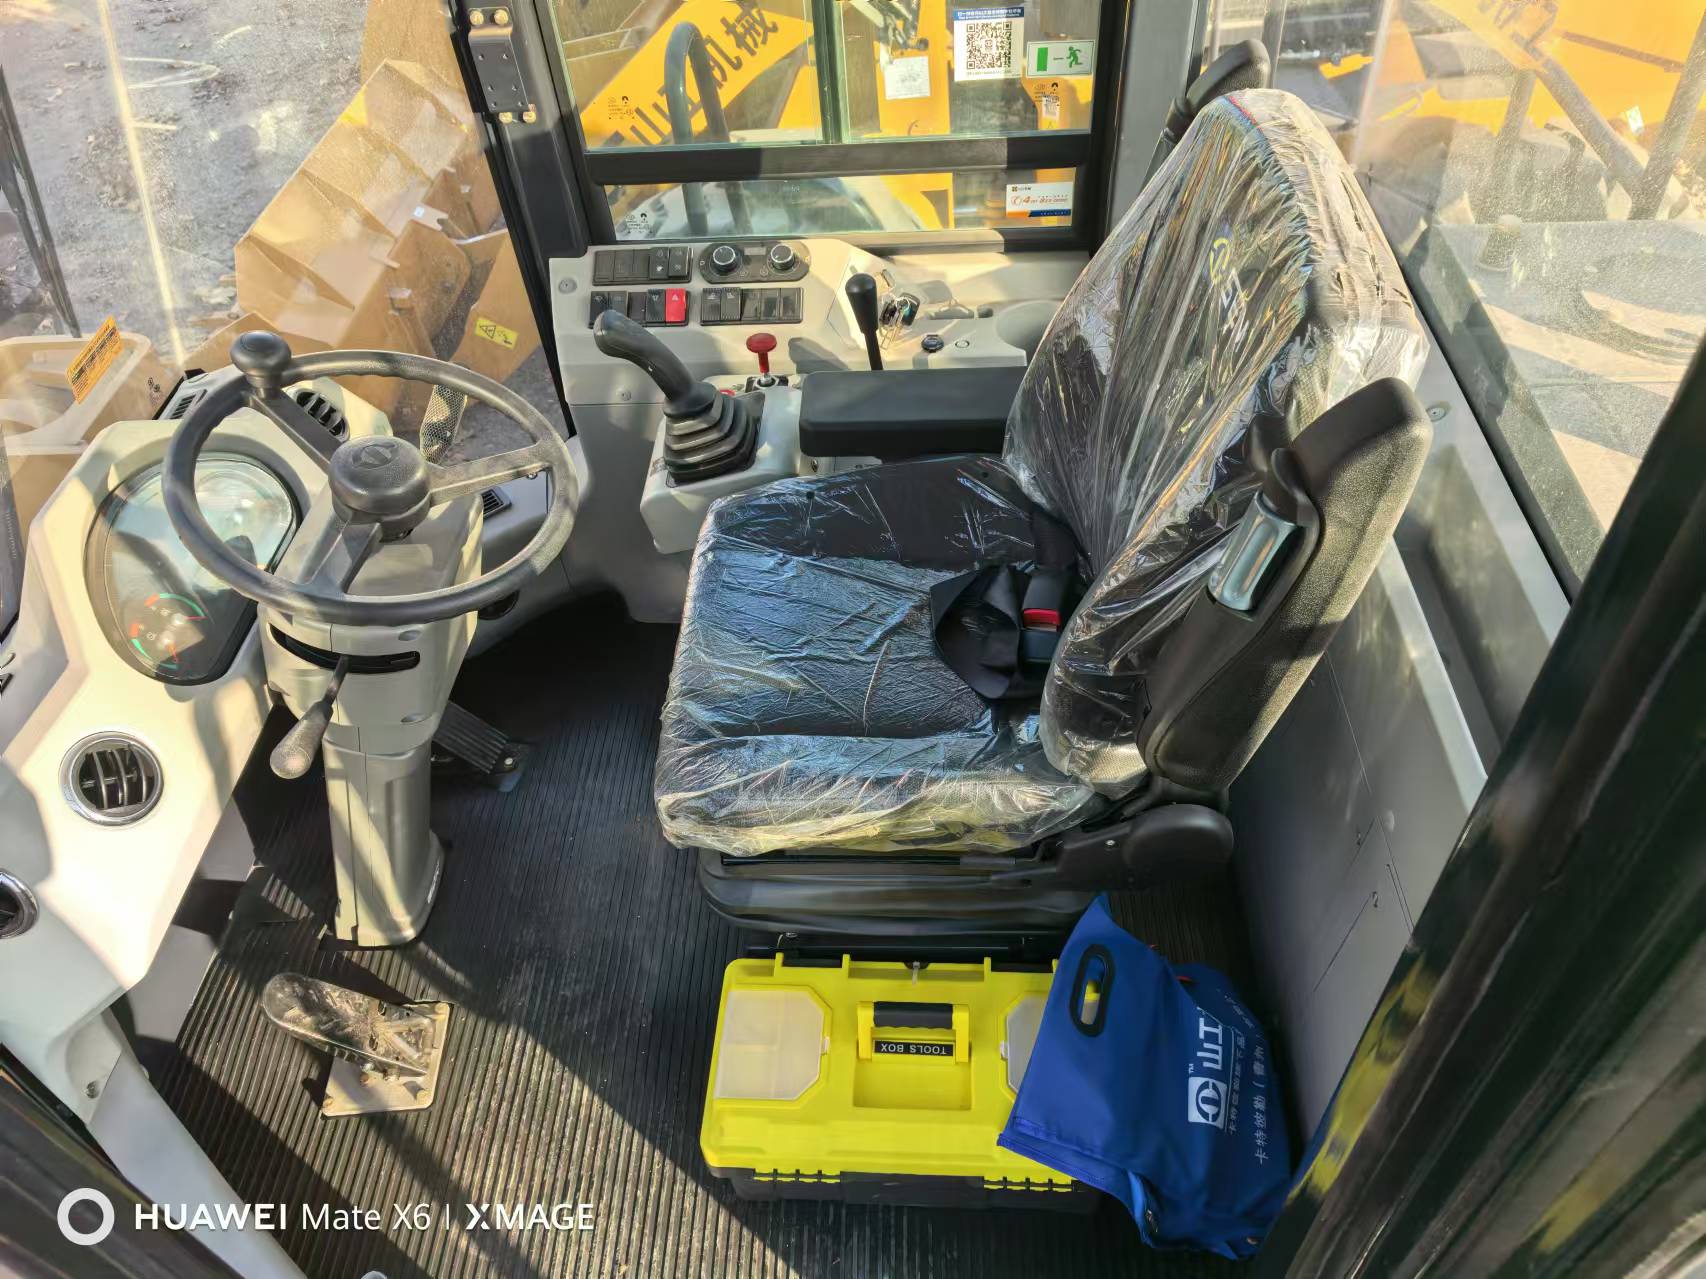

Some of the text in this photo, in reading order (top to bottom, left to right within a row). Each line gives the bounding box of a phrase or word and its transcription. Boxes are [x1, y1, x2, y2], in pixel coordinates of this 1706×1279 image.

[880, 1043, 947, 1055] TOOLS BOX
[1197, 1017, 1223, 1070] 山工
